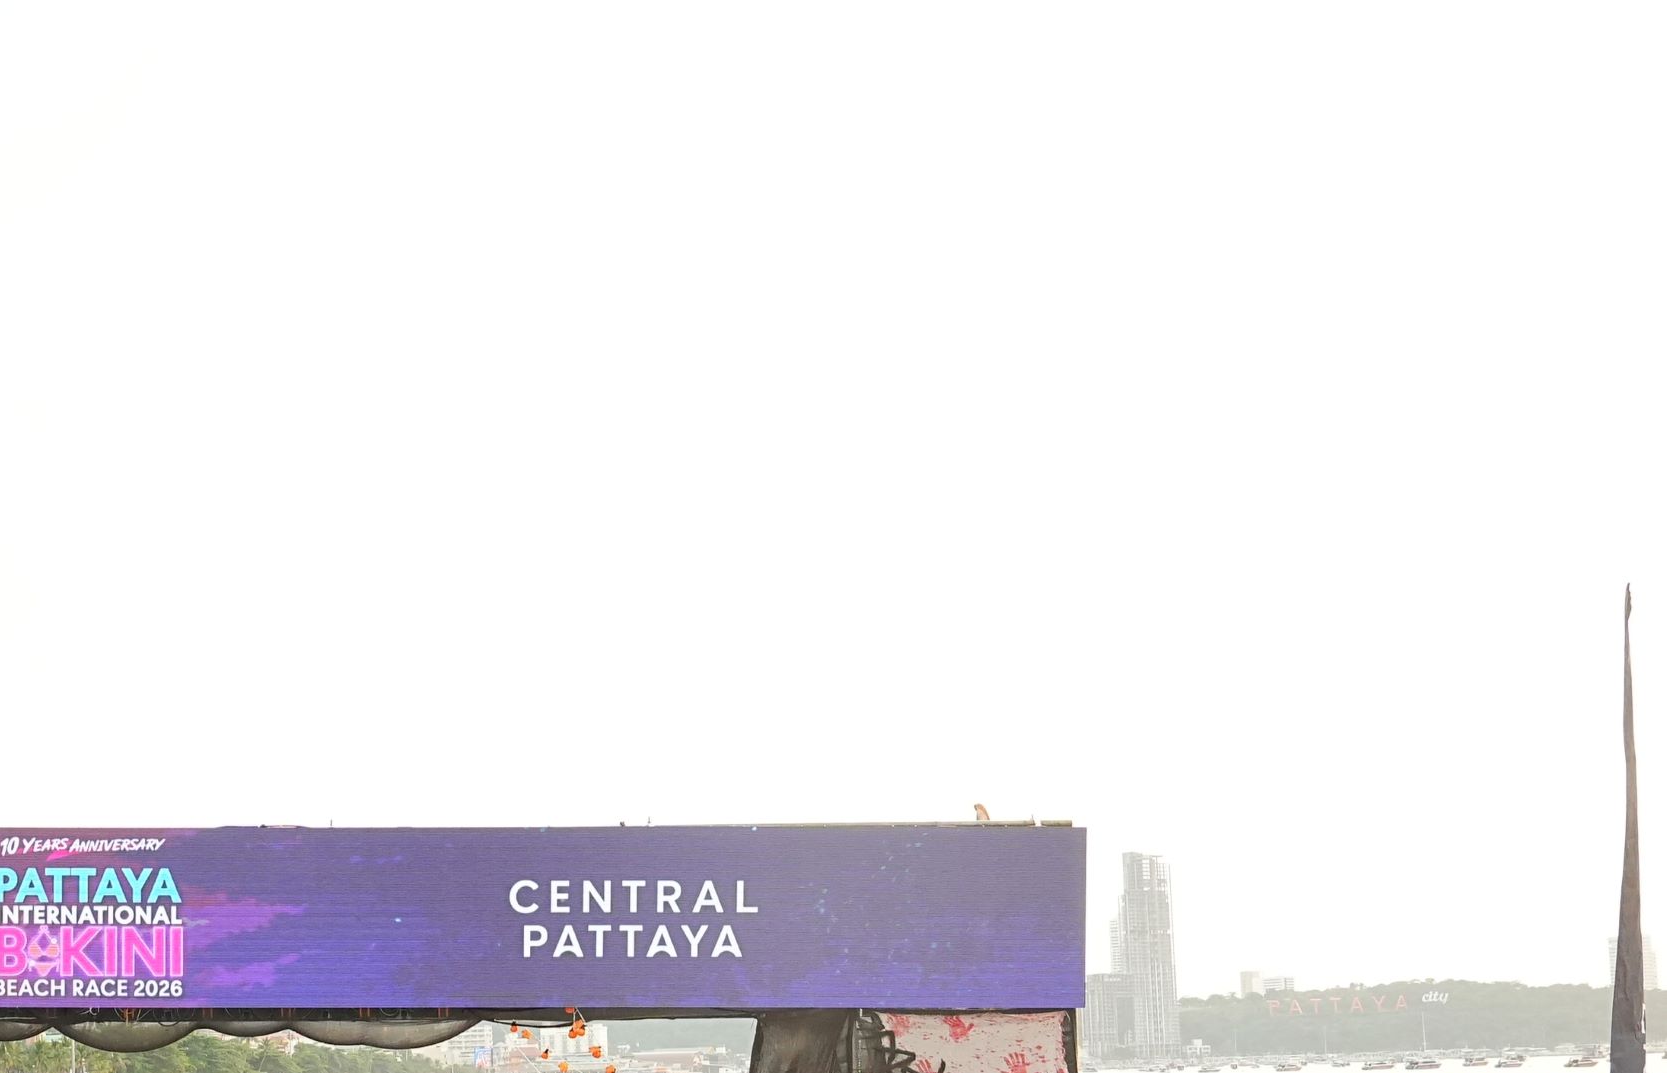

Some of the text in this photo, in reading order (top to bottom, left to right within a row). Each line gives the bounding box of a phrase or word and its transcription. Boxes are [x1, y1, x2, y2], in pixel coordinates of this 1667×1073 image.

[0, 836, 166, 856] 10 YEARS ANNIVERSARY
[509, 879, 759, 914] CENTRAL
[523, 924, 743, 958] PATTAYA
[72, 979, 128, 997] RACE
[133, 980, 183, 997] 2026
